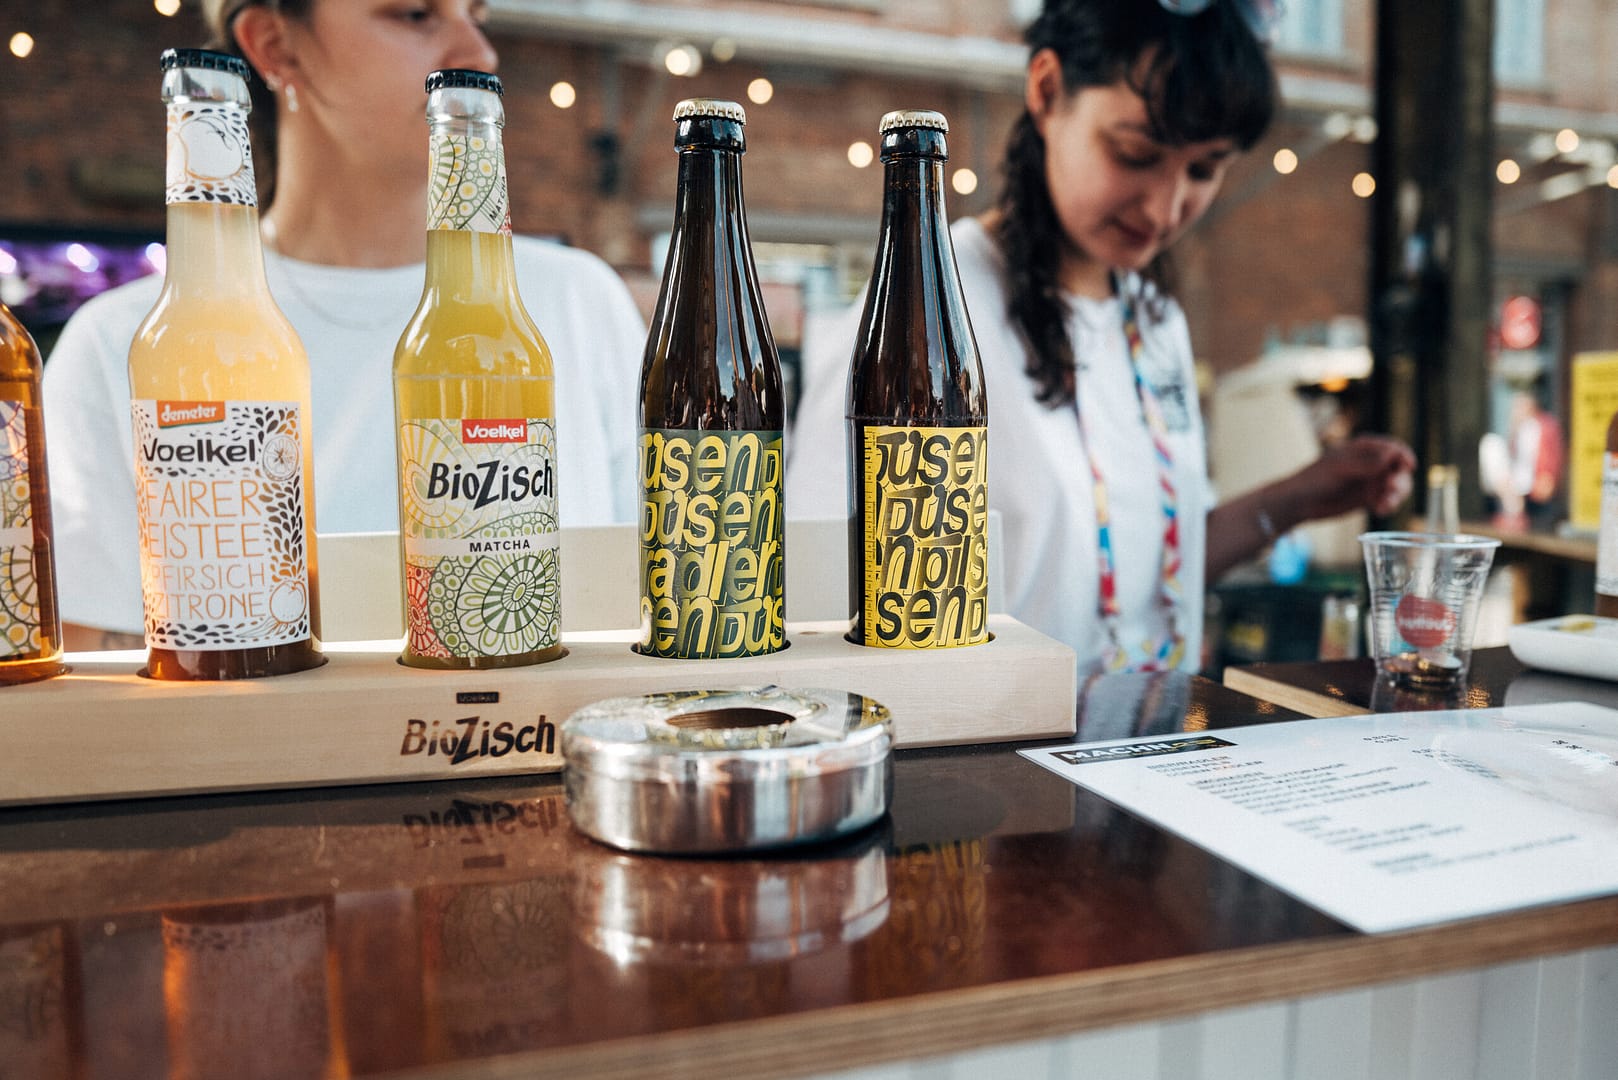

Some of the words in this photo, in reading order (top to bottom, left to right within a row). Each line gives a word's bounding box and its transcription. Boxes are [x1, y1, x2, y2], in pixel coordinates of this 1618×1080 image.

[160, 404, 217, 423] demeter
[466, 425, 524, 439] Voelkel
[143, 438, 256, 466] Voelkel
[144, 479, 262, 518] FAIRER
[427, 459, 553, 511] BioZisch
[149, 522, 265, 560] EISTEE
[469, 540, 530, 553] MATCHA
[150, 563, 265, 591] PFIRSICH
[154, 592, 266, 620] ZITRONE
[400, 715, 555, 765] BioZisch
